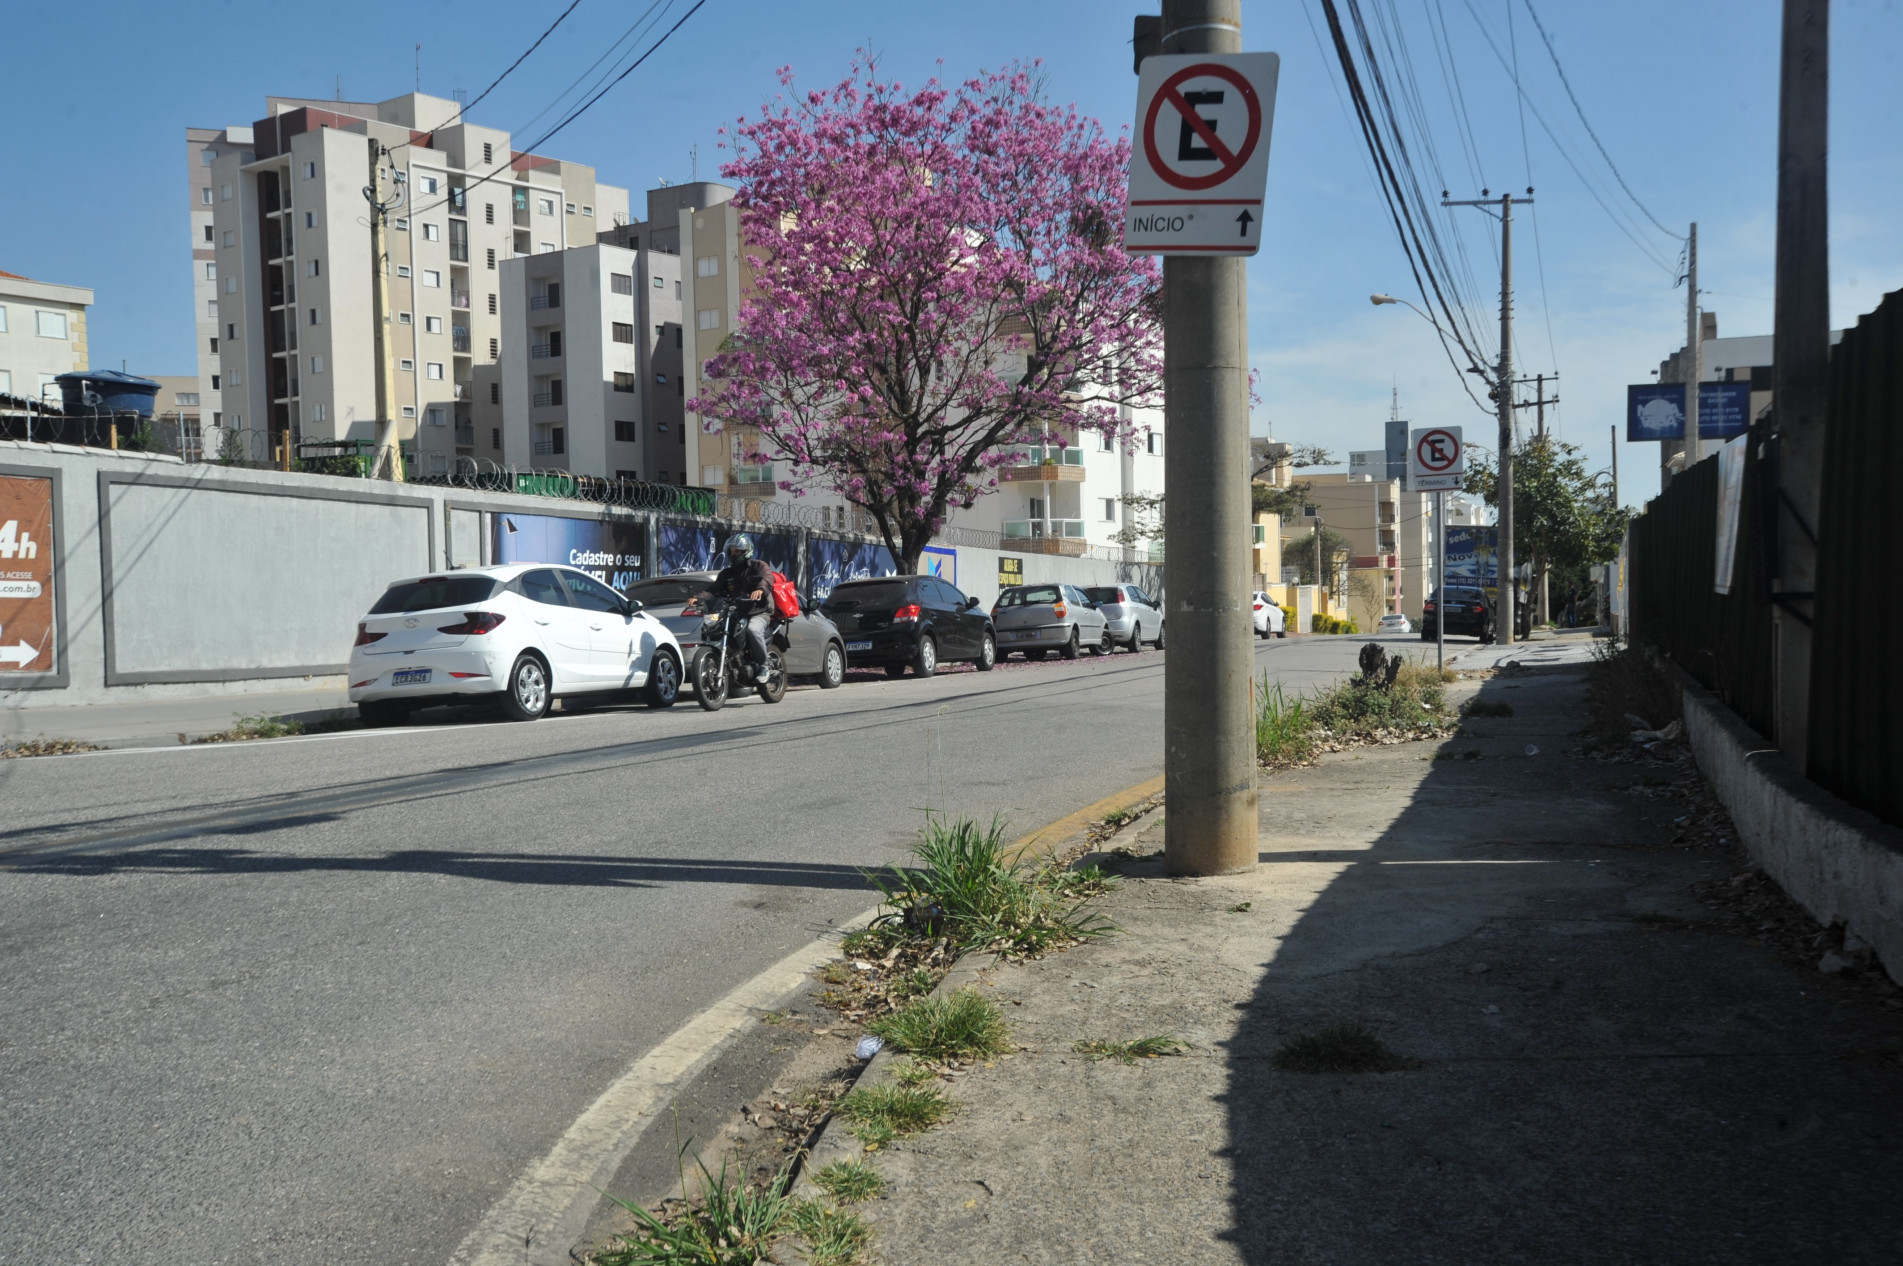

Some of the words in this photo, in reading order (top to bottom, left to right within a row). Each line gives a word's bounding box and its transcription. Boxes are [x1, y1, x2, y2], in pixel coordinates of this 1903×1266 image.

[1178, 91, 1224, 161] E
[1133, 214, 1185, 232] INÍCIO
[1431, 439, 1446, 462] E
[1417, 479, 1447, 487] TÉRMINO
[569, 549, 614, 566] Cadastre
[616, 554, 622, 565] o
[624, 554, 641, 567] seu
